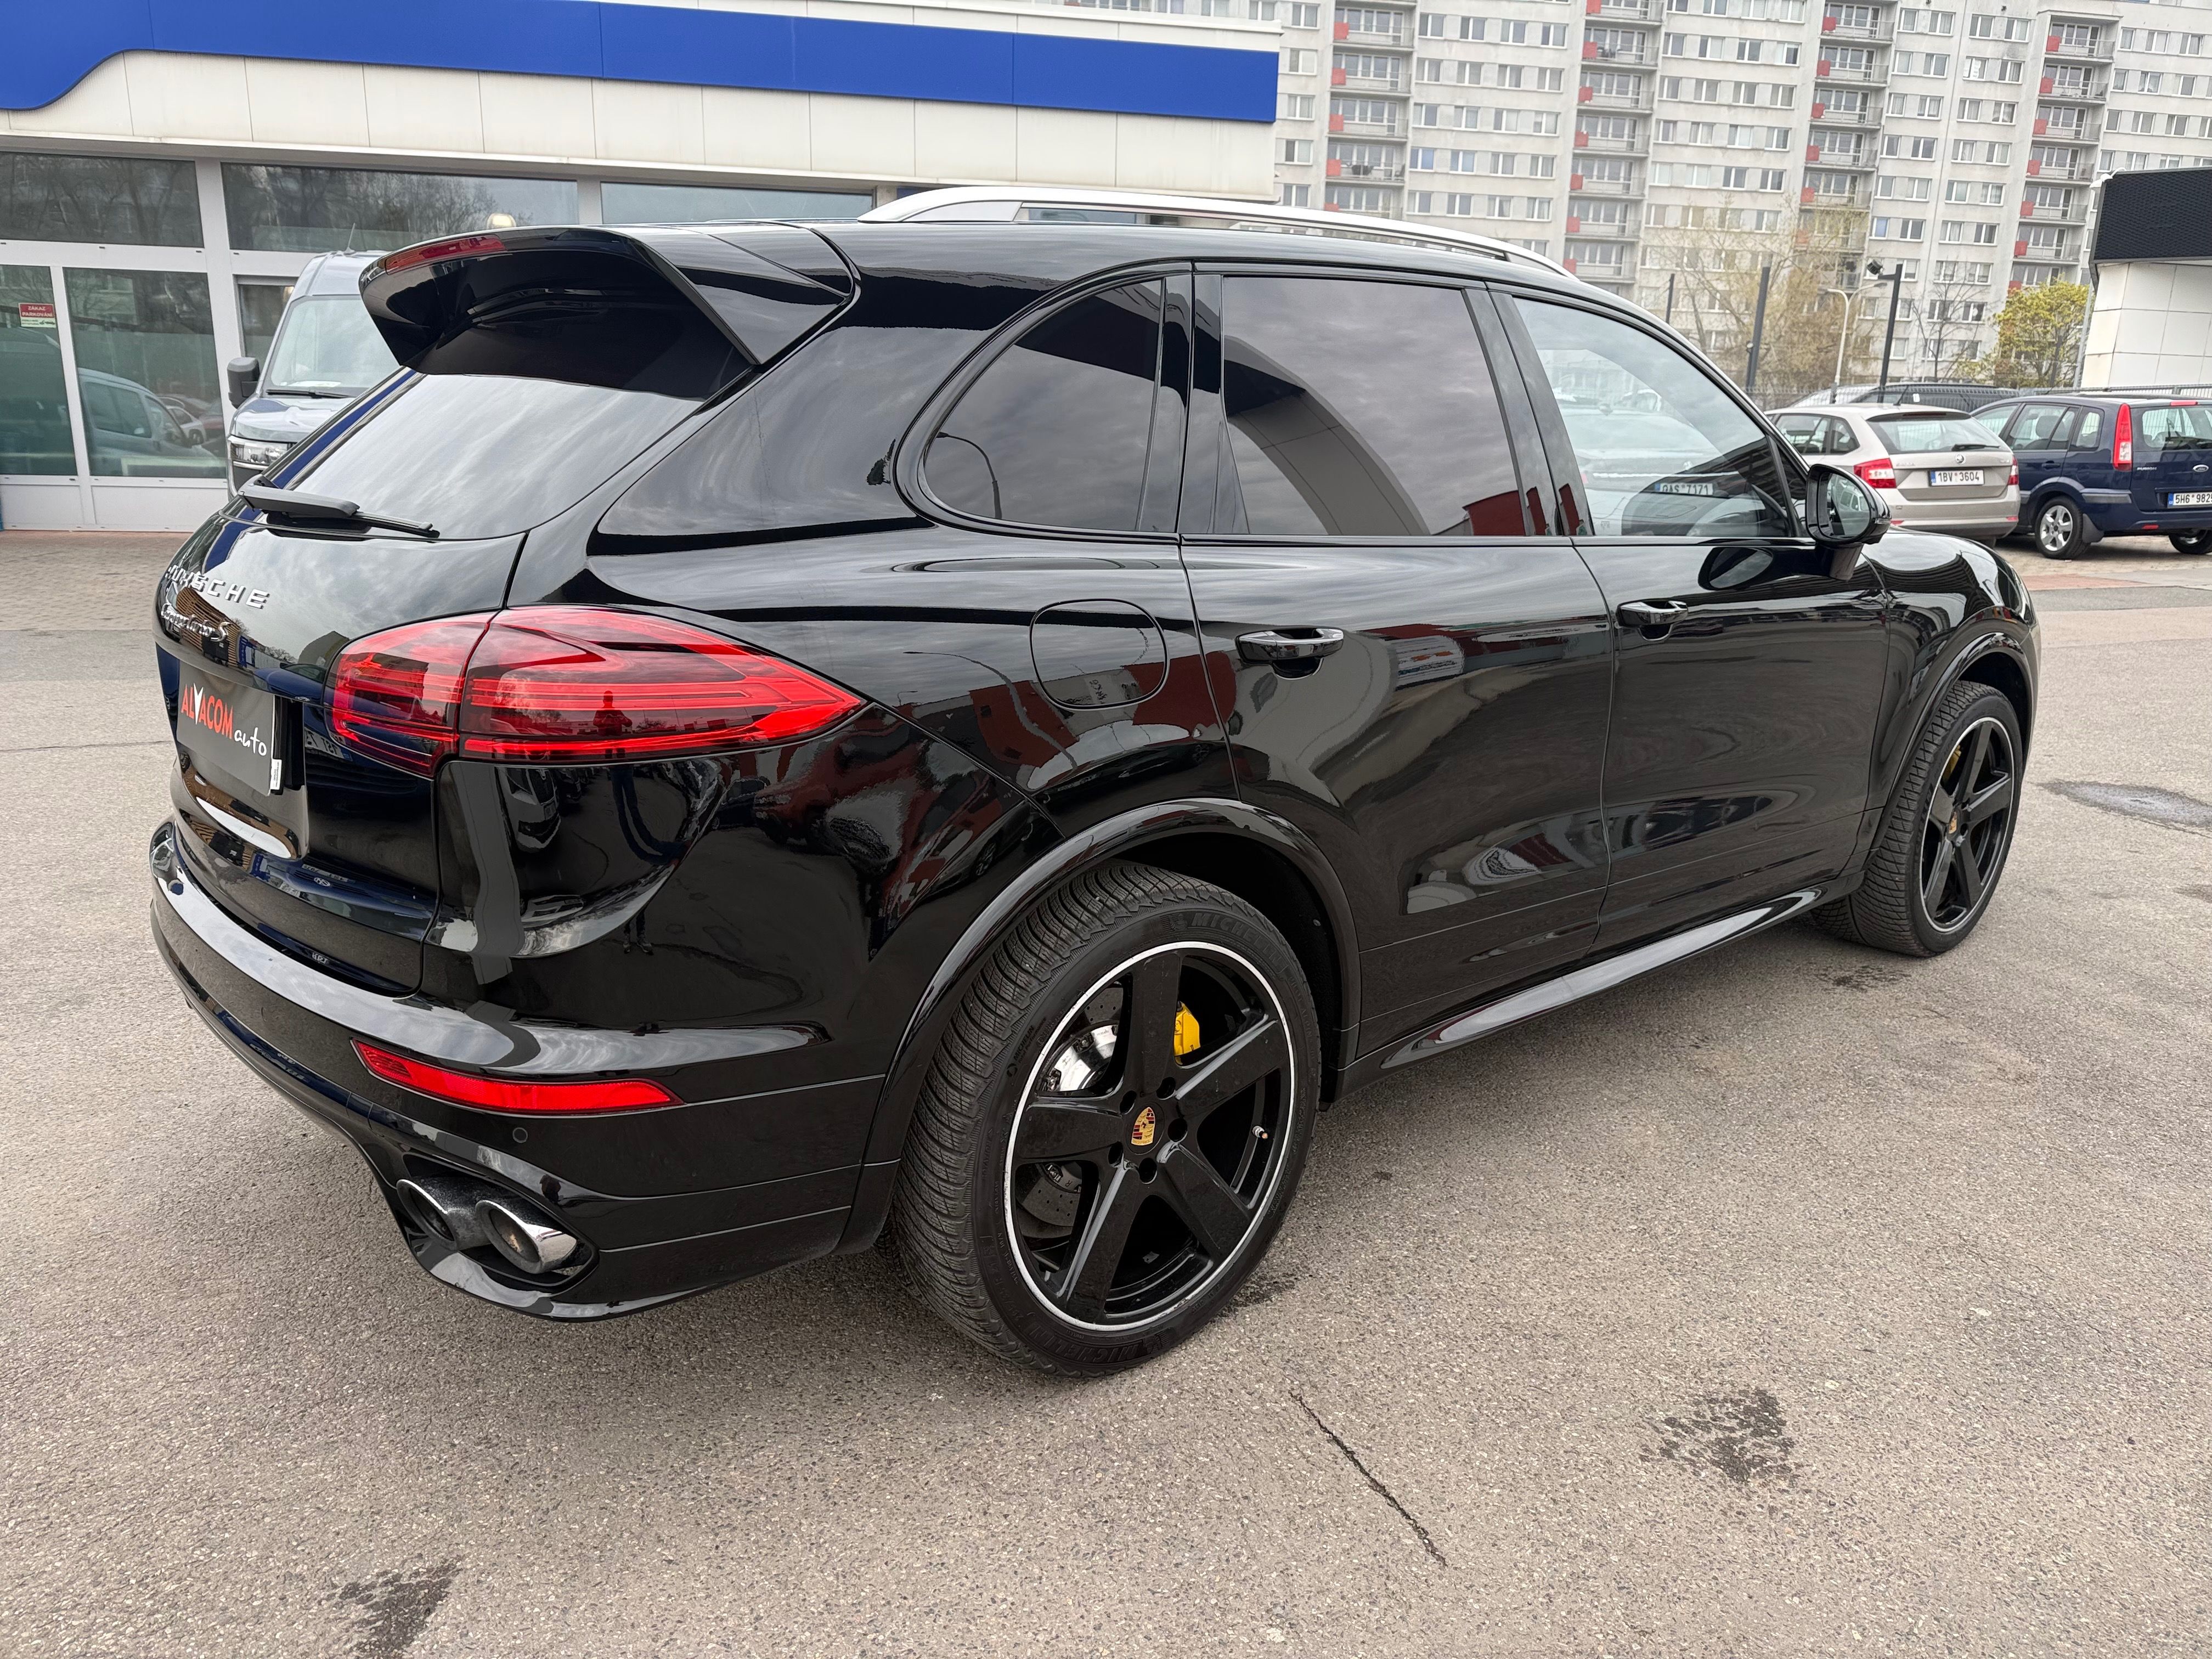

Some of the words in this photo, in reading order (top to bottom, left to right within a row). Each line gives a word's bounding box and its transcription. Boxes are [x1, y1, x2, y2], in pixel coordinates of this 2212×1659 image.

[1686, 484, 1708, 495] 7171
[1938, 472, 1953, 482] 1BV
[1959, 471, 1979, 482] 3604
[2175, 495, 2190, 504] 5H6
[180, 683, 234, 740] ALVACOM
[234, 727, 267, 757] auto
[1190, 912, 1284, 970] MICHELIN
[1013, 1024, 1035, 1061] MICHELIN
